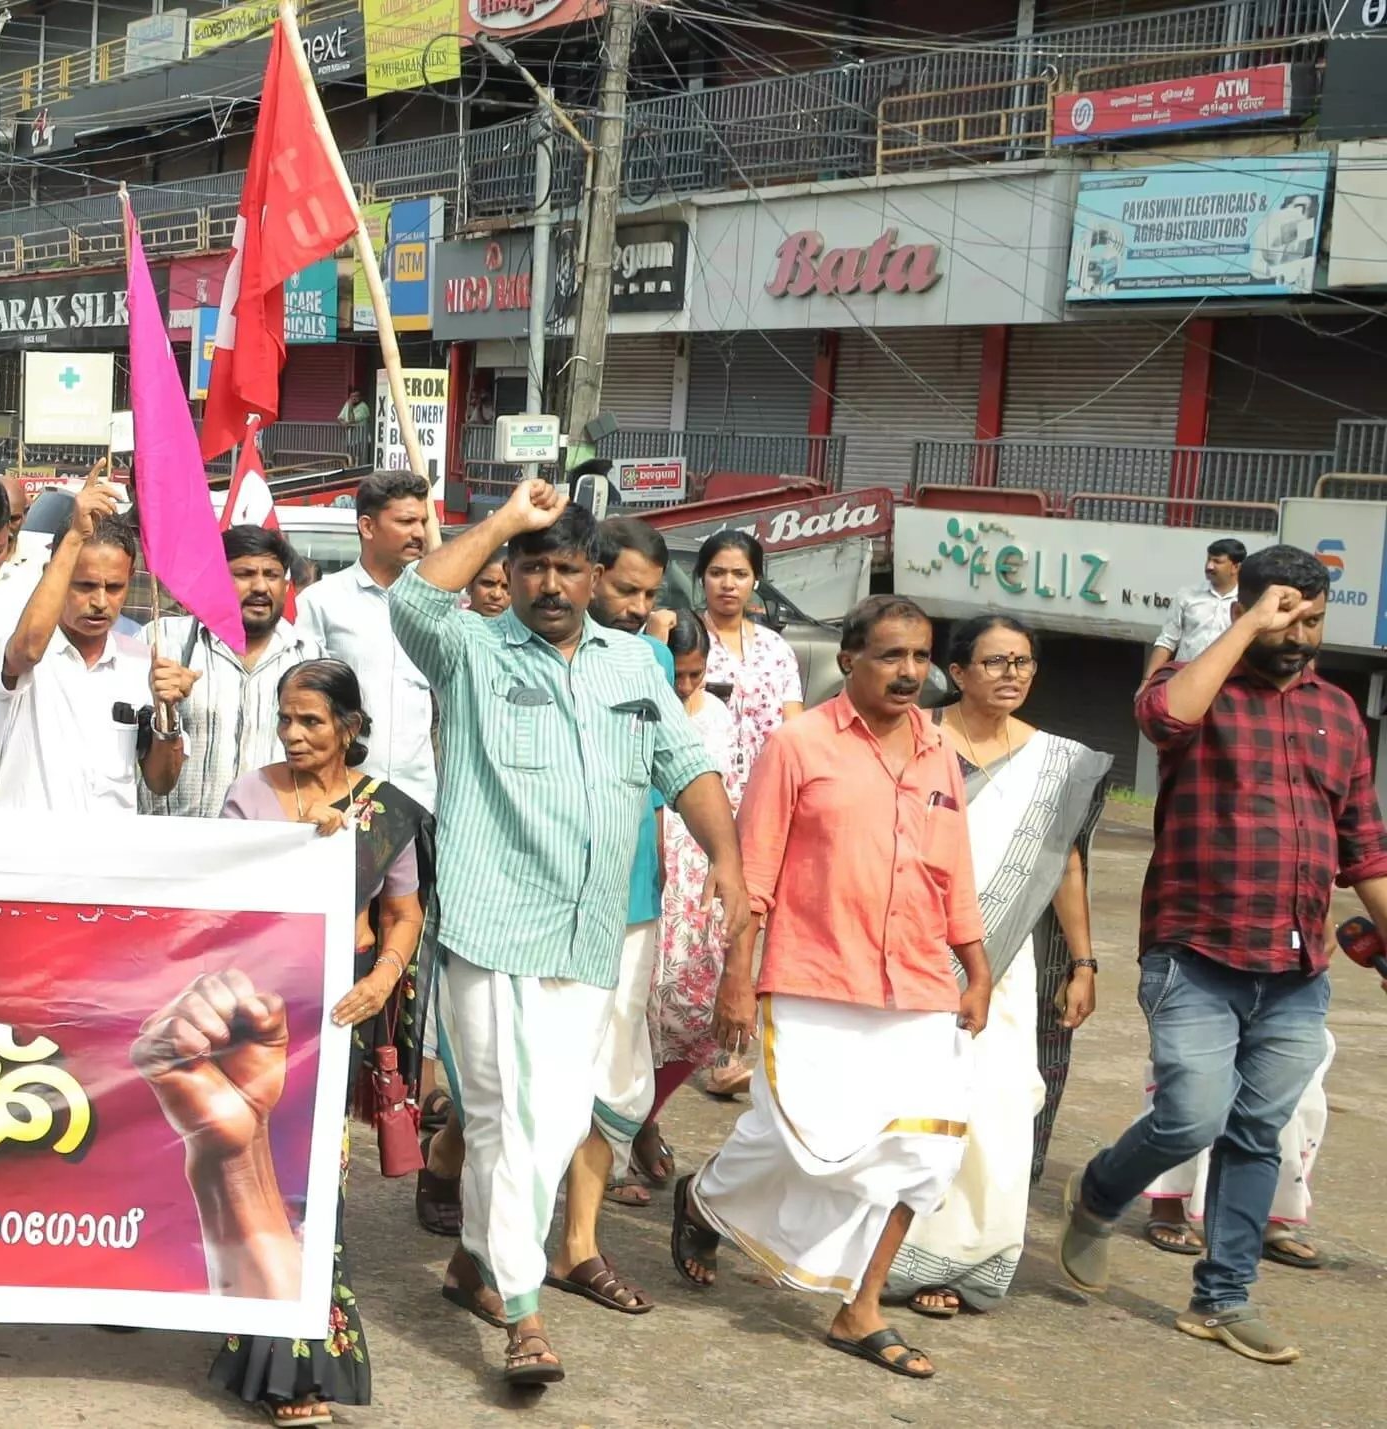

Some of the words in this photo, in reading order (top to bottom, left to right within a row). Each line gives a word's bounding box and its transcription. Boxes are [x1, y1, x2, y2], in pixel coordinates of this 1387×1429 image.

[1215, 77, 1249, 99] ATM
[1122, 197, 1184, 223] PAYASWINI
[1184, 191, 1257, 216] ELECTRICALS
[1258, 195, 1268, 212] &
[1133, 223, 1164, 244] AGRO
[1165, 217, 1248, 241] DISTRIBUTORS
[398, 251, 423, 273] ATM
[765, 227, 944, 299] Bata
[70, 290, 130, 328] SILK
[404, 378, 445, 398] EROX
[390, 428, 435, 446] BKS
[766, 501, 881, 544] Bata
[969, 544, 1109, 604] FELIZ
